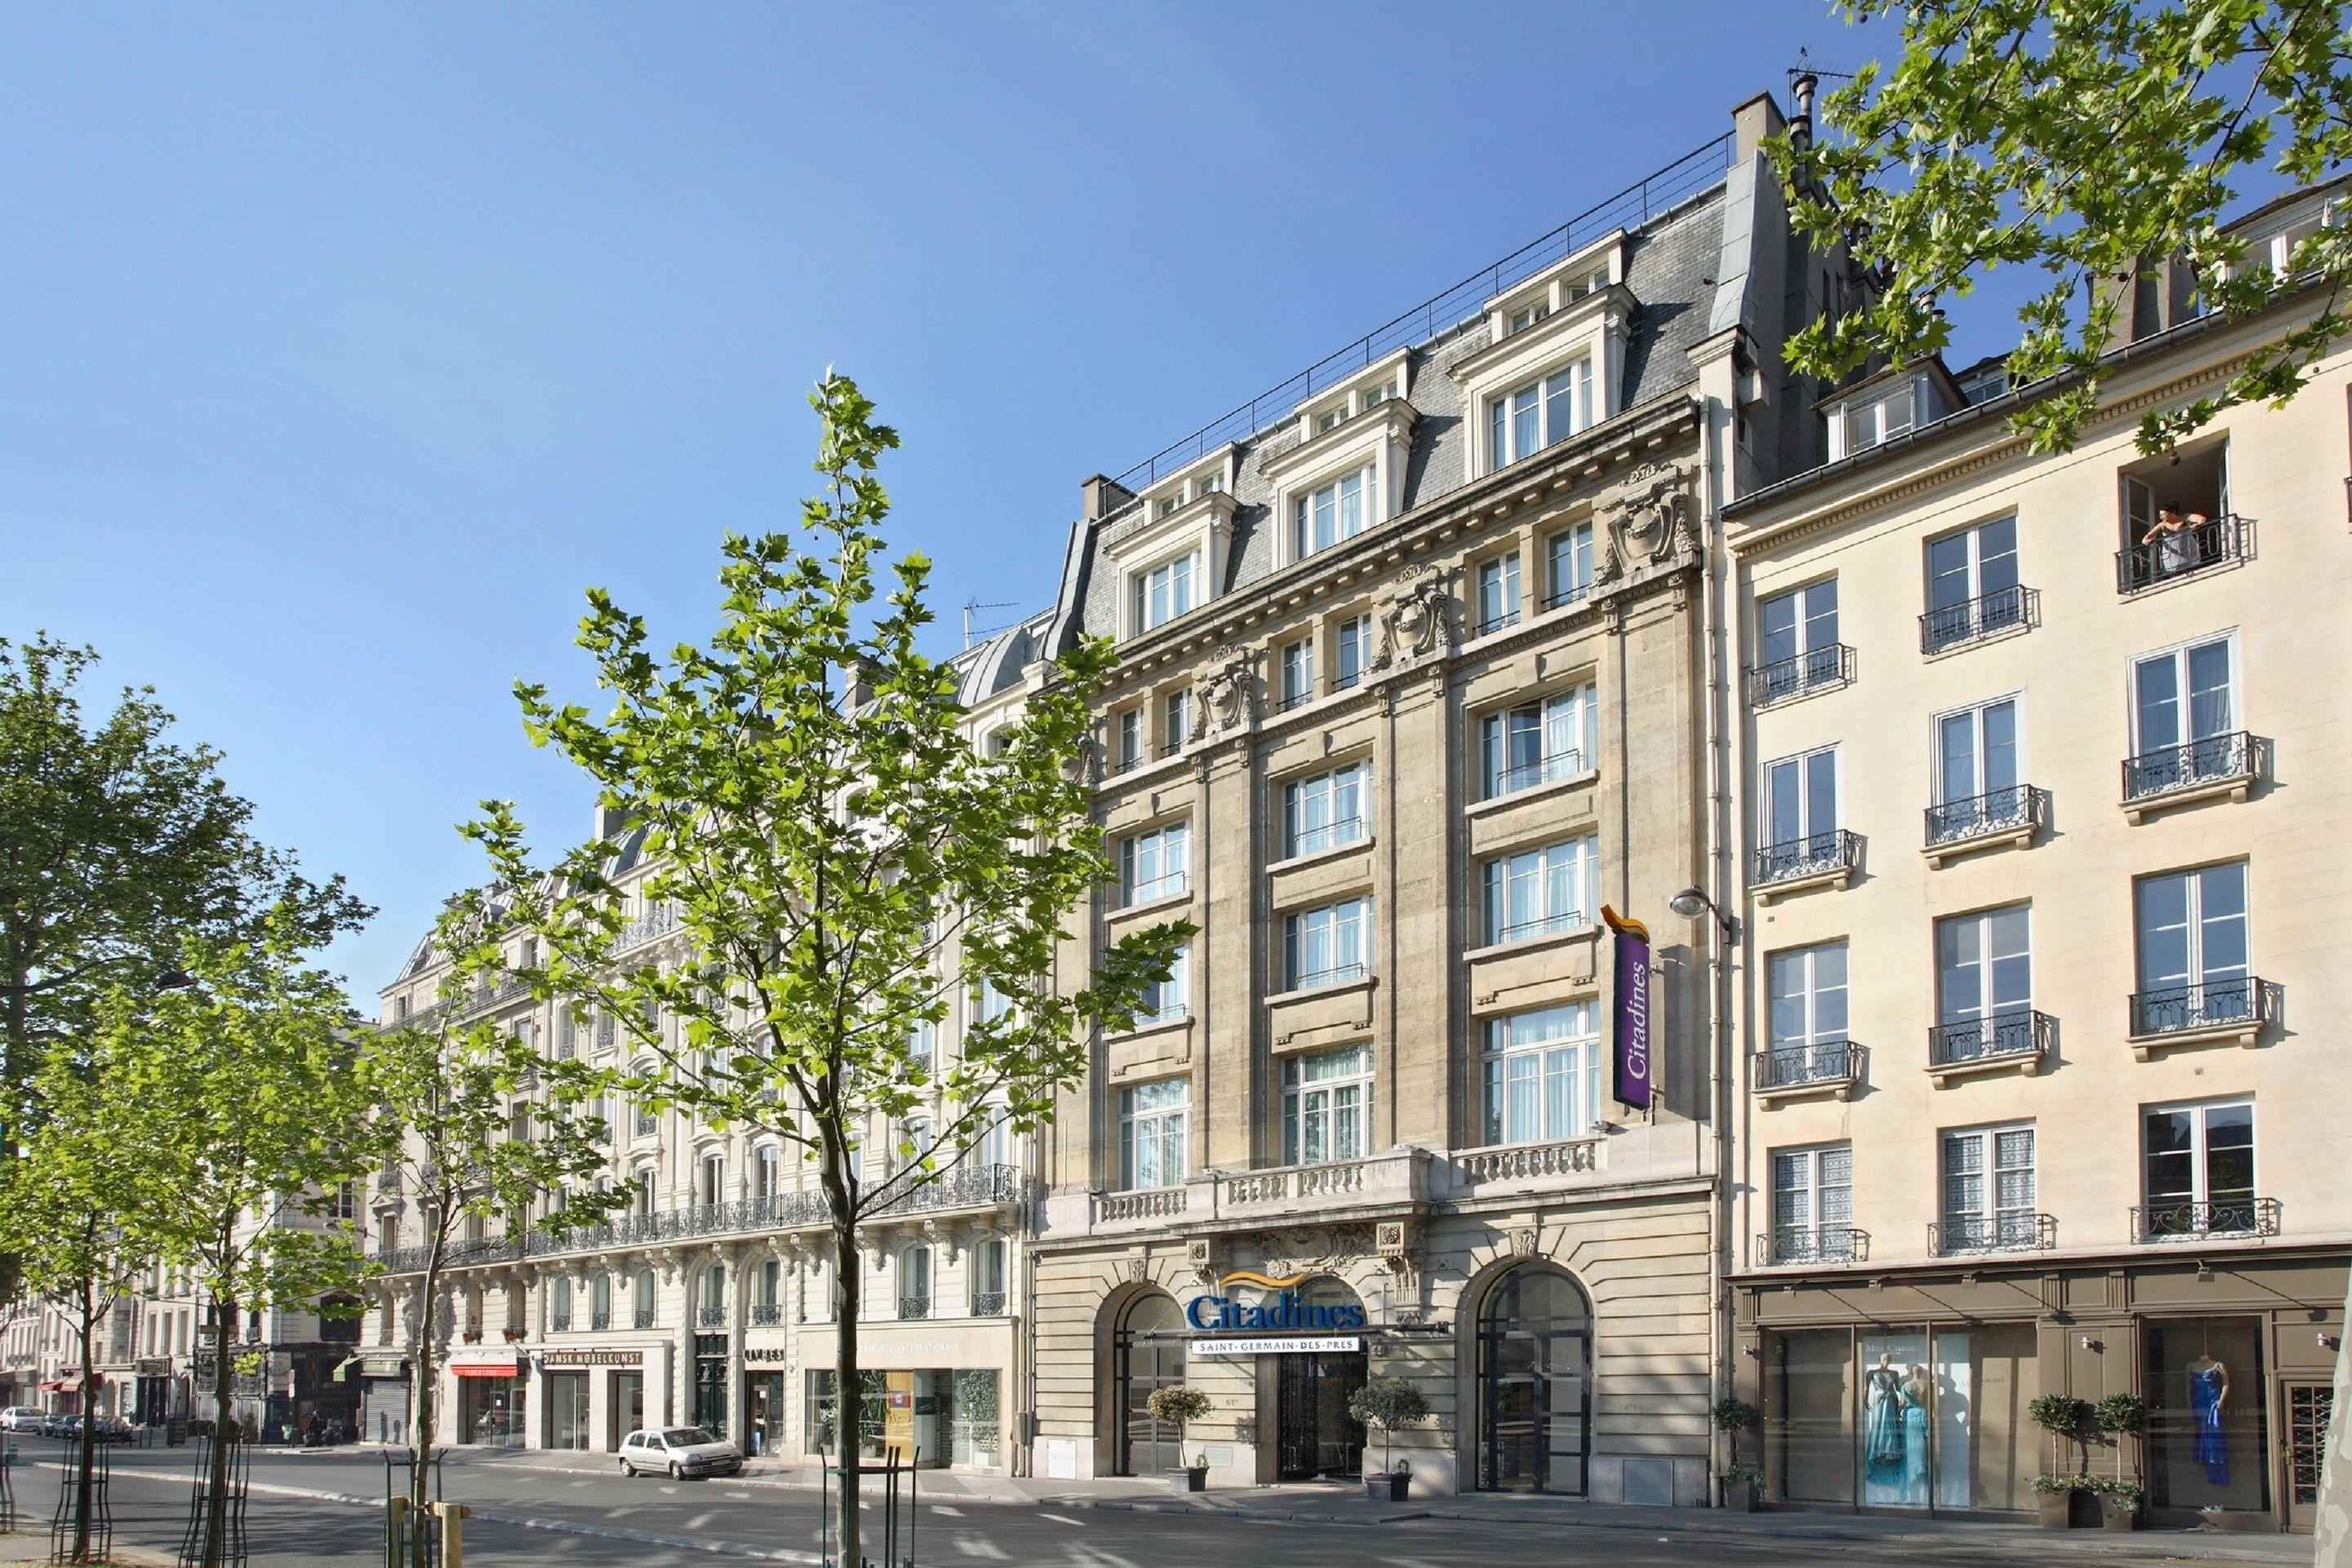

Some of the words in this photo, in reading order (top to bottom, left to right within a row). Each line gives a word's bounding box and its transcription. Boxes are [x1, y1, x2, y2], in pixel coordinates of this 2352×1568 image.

[1626, 961, 1646, 1080] Citadines
[1187, 1293, 1364, 1329] Citadines
[857, 1344, 894, 1353] ANSPORTS
[1200, 1341, 1353, 1352] SAINT-GERMAIN-DES-PRES
[543, 1354, 573, 1365] DANSK
[576, 1353, 641, 1364] MØBELKUNST
